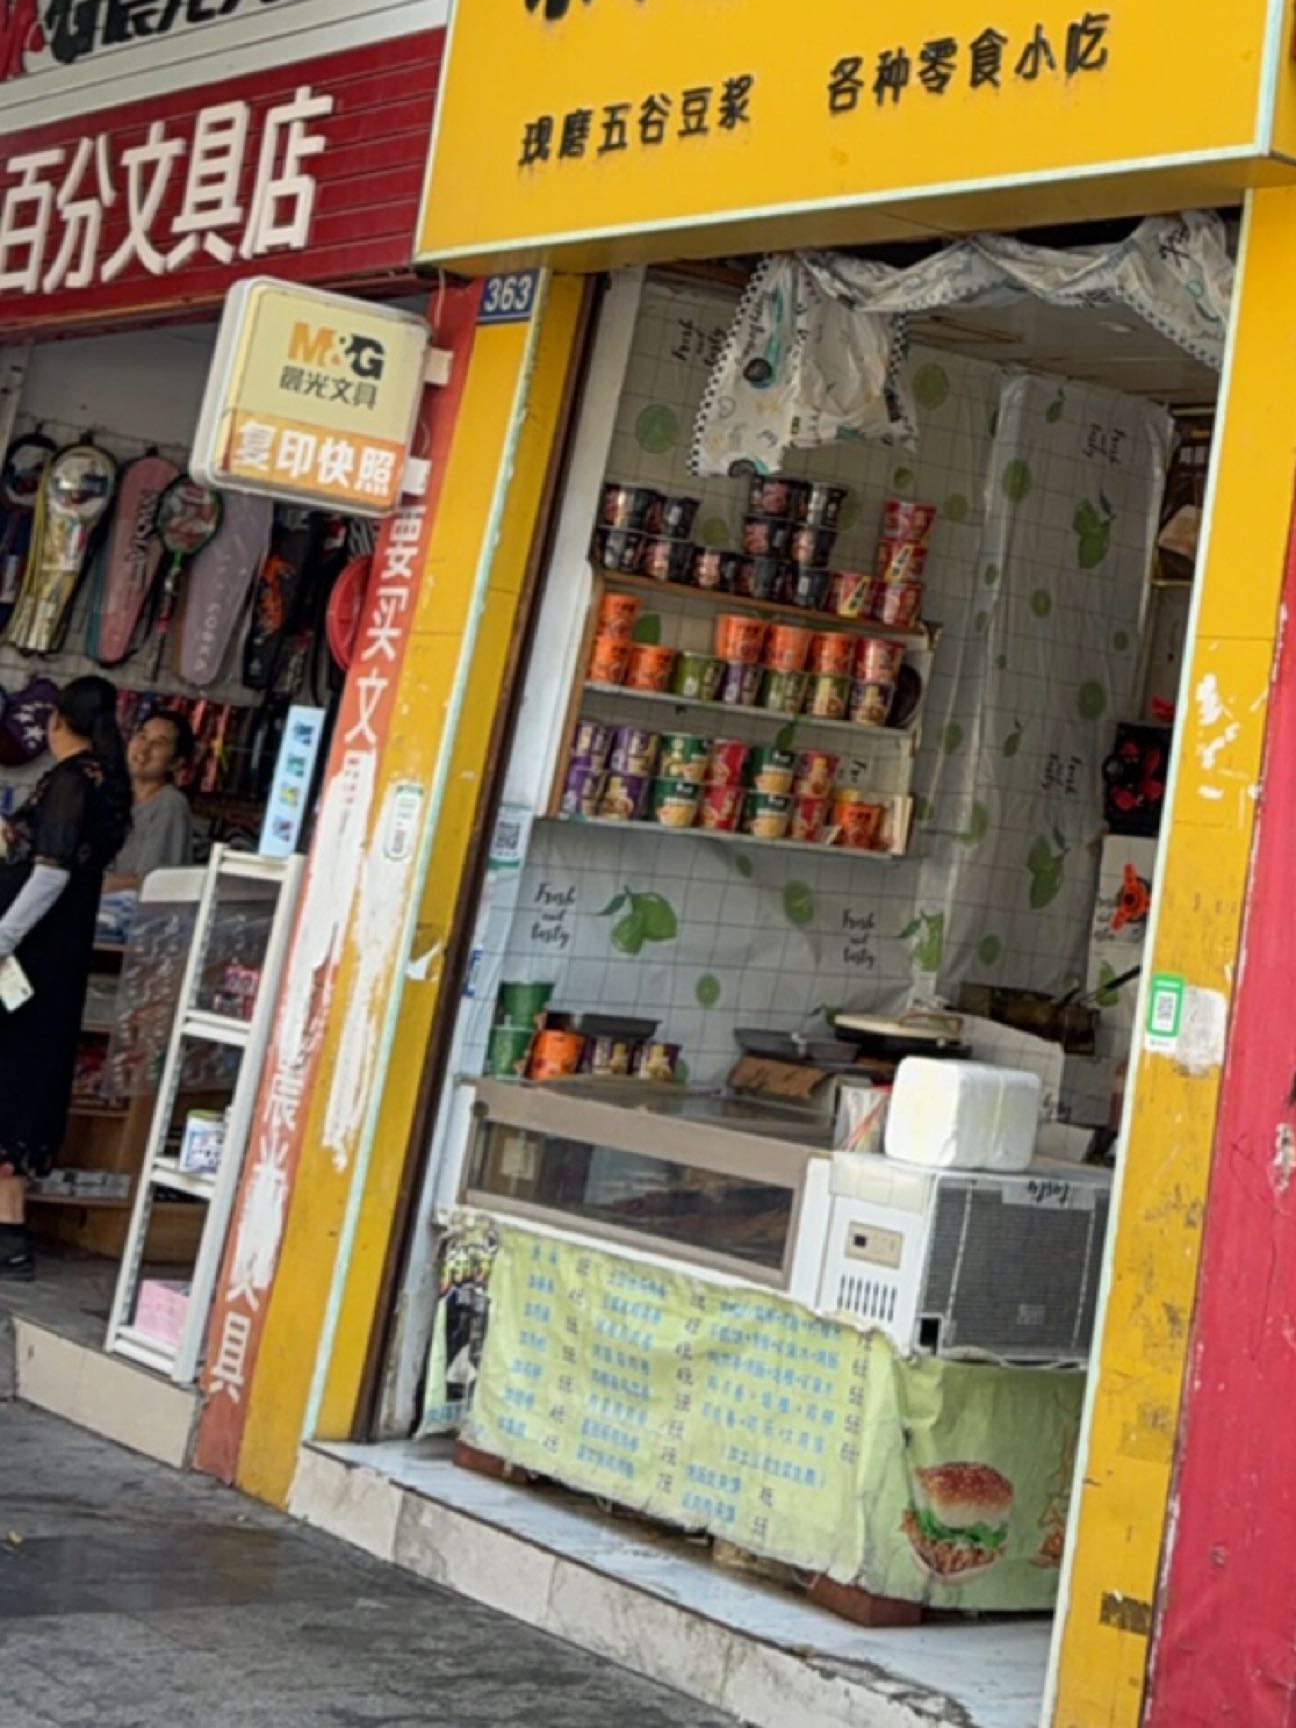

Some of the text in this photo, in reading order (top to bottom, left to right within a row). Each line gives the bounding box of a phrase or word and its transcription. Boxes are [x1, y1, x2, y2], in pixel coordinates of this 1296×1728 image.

[518, 12, 1110, 168] 现磨五谷豆浆 各种零食小吃
[484, 274, 533, 313] 363
[287, 321, 386, 381] M&G
[234, 419, 396, 497] 复印快照
[338, 504, 428, 807] 要买文
